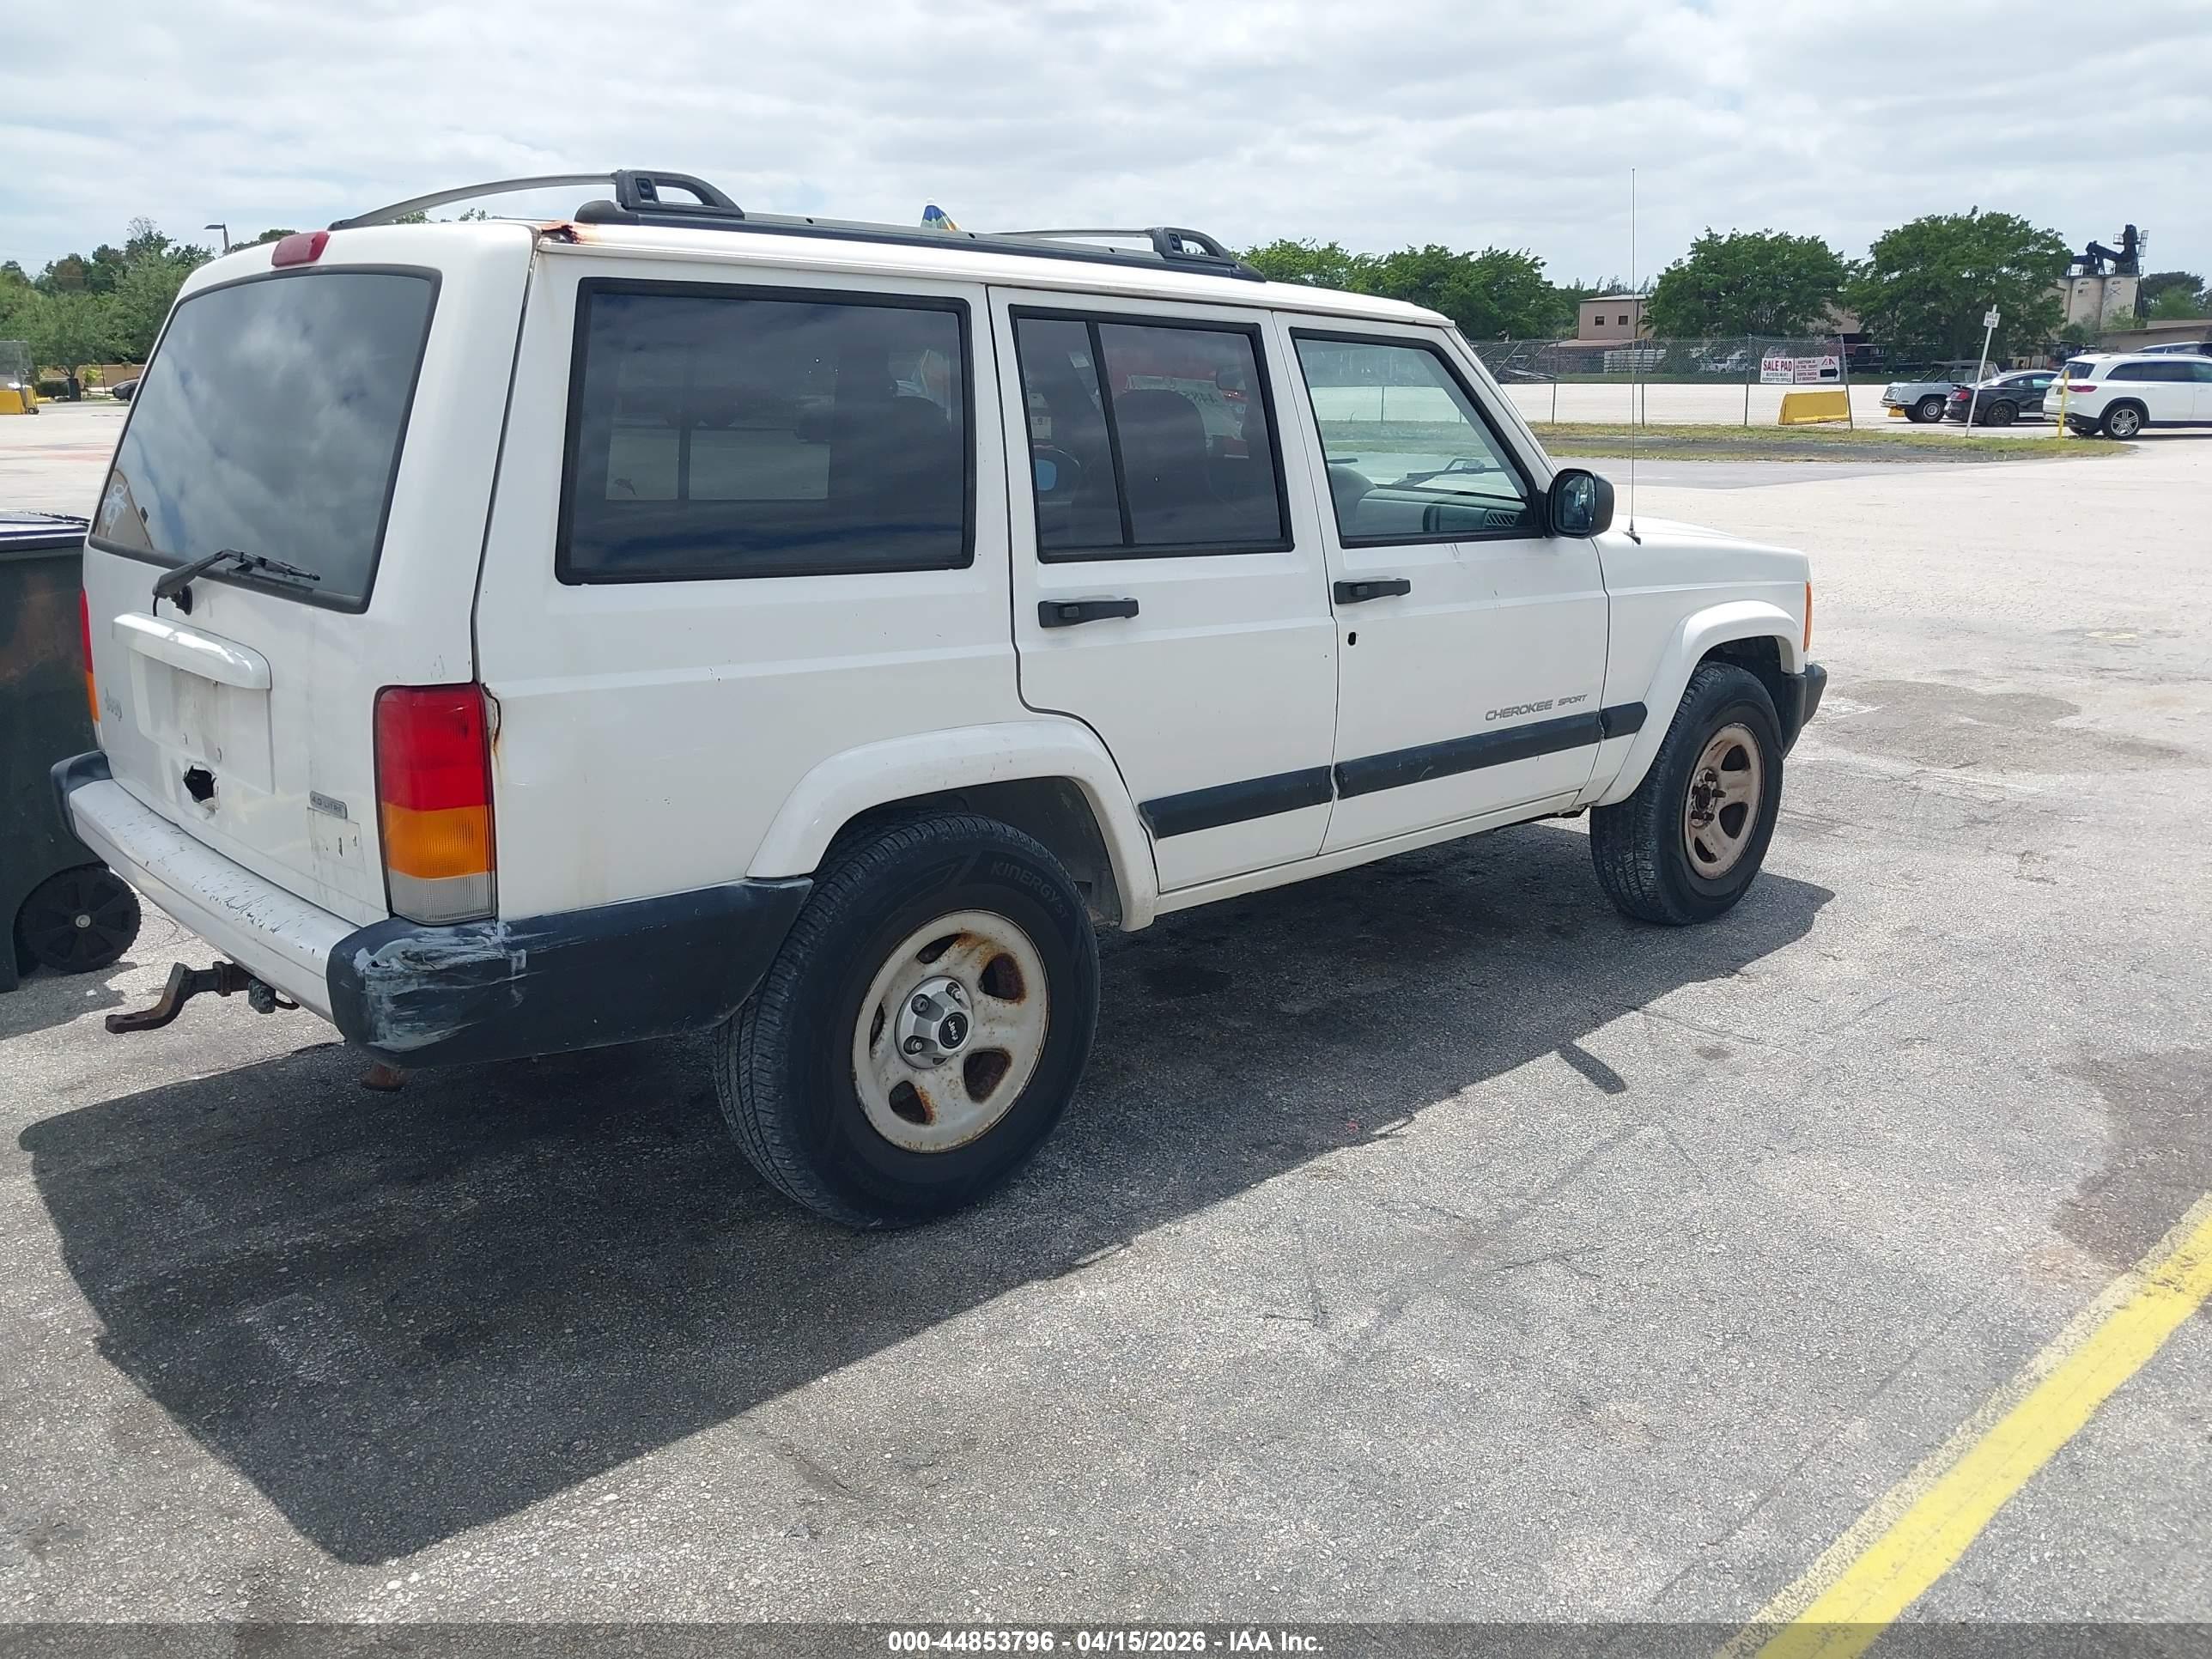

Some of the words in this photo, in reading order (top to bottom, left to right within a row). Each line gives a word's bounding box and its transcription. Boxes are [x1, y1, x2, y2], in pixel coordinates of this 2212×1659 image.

[1763, 360, 1778, 371] SALE
[1780, 361, 1792, 372] PAD
[1485, 700, 1553, 721] CHEROKEE
[1558, 694, 1588, 706] SPORT
[947, 1020, 959, 1042] Jeep
